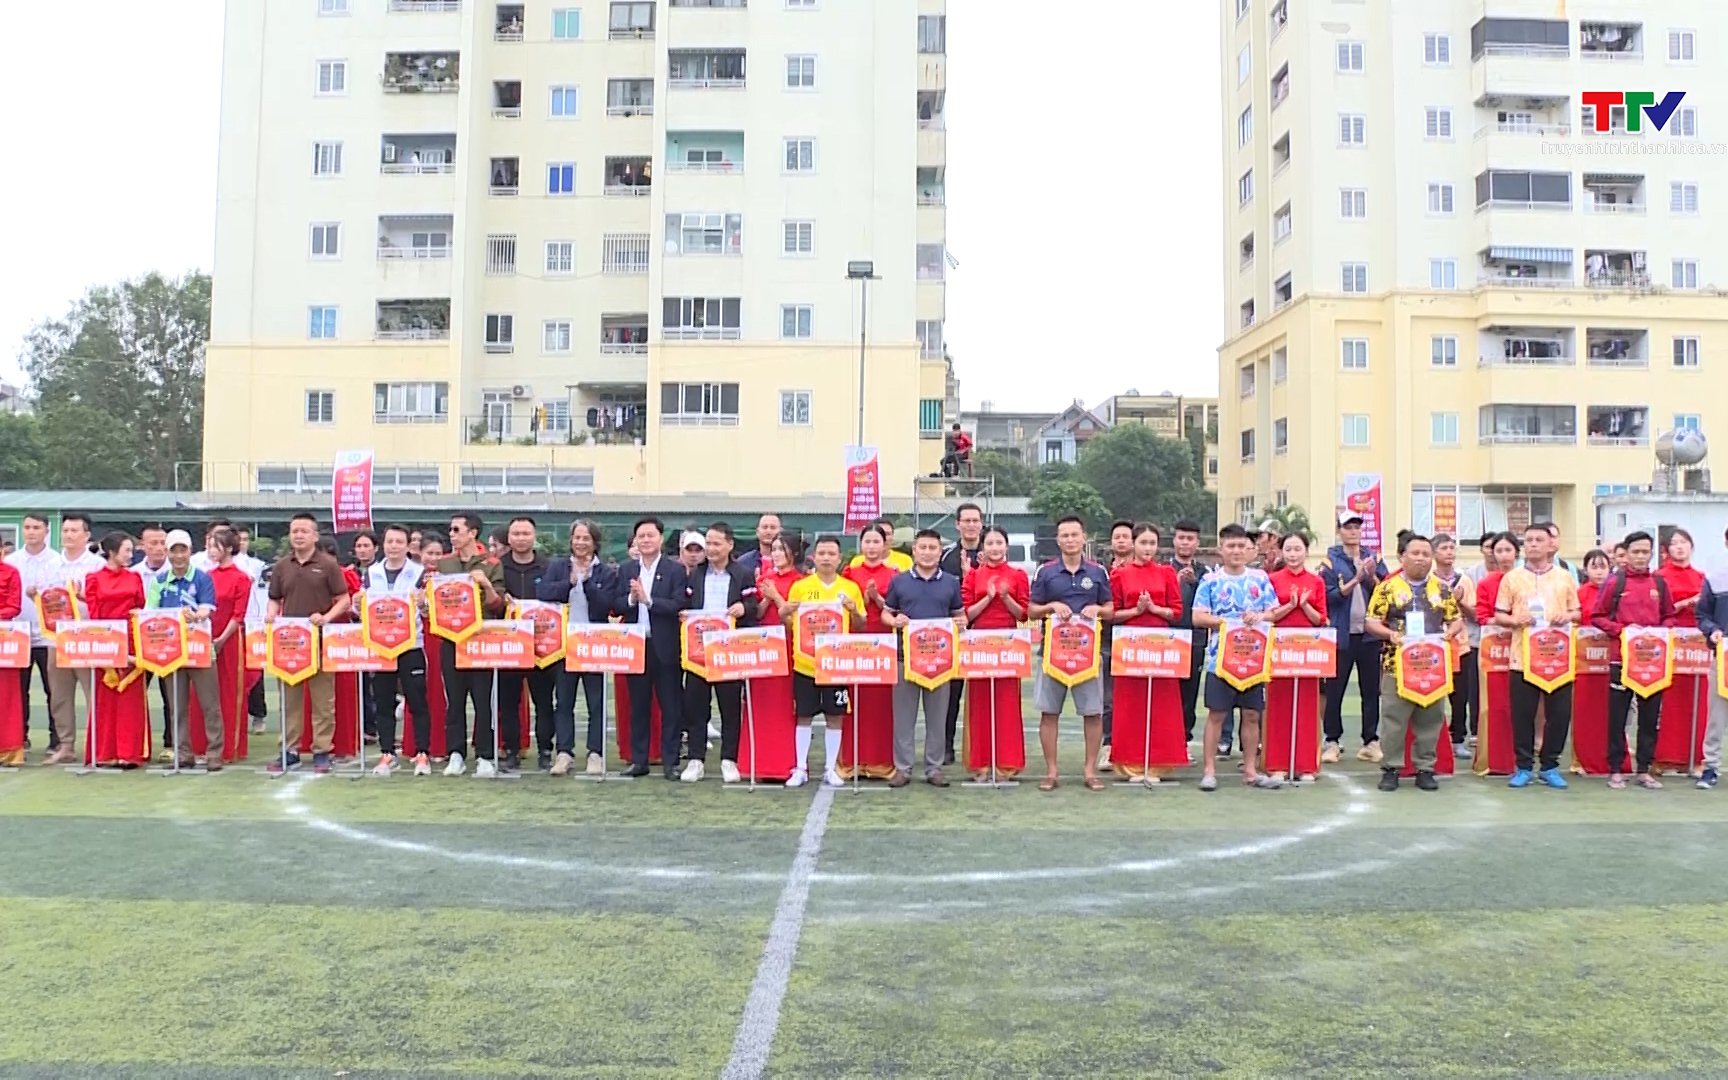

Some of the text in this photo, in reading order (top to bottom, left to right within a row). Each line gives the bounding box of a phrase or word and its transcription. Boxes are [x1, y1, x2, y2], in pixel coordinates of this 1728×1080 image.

[64, 641, 77, 654] FC
[466, 641, 479, 655] FC
[576, 643, 589, 657] FC
[1490, 646, 1502, 658] FC
[713, 652, 727, 667] FC
[729, 650, 757, 665] Trung
[958, 650, 972, 664] FC
[1122, 648, 1135, 662] FC
[821, 656, 835, 671] FC
[835, 690, 848, 706] 28
